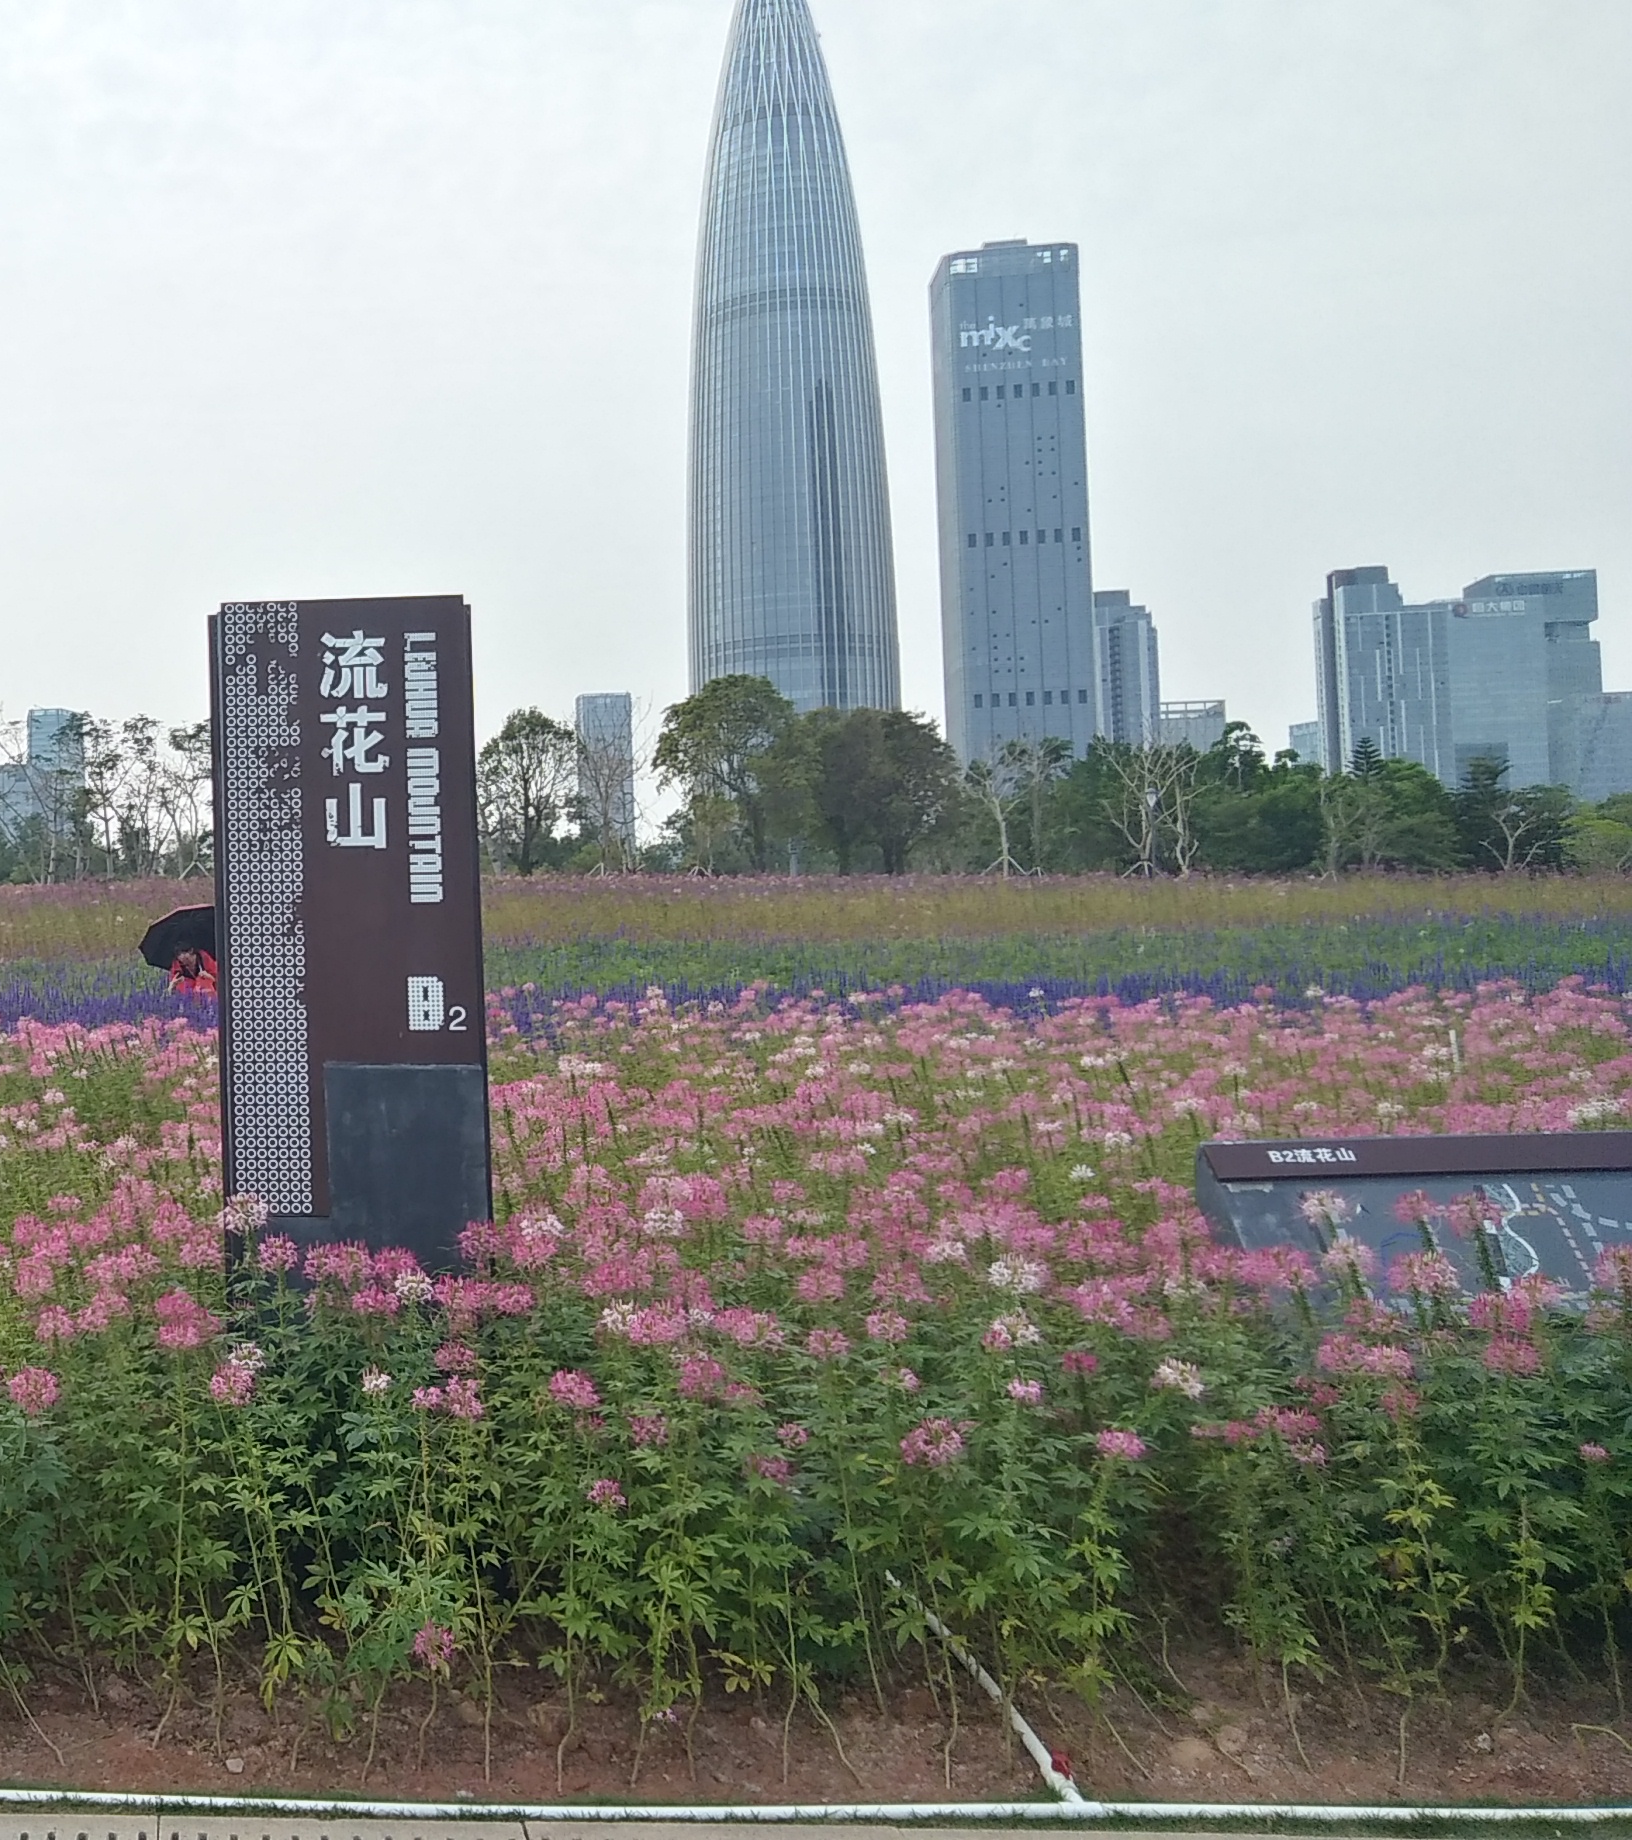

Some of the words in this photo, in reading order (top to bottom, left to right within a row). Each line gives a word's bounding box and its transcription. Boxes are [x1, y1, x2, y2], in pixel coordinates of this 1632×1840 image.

[319, 630, 390, 849] 流花山
[404, 632, 438, 738] LIUHUA
[407, 748, 443, 903] MOUNTAIN
[1267, 1148, 1357, 1163] B2流花山
